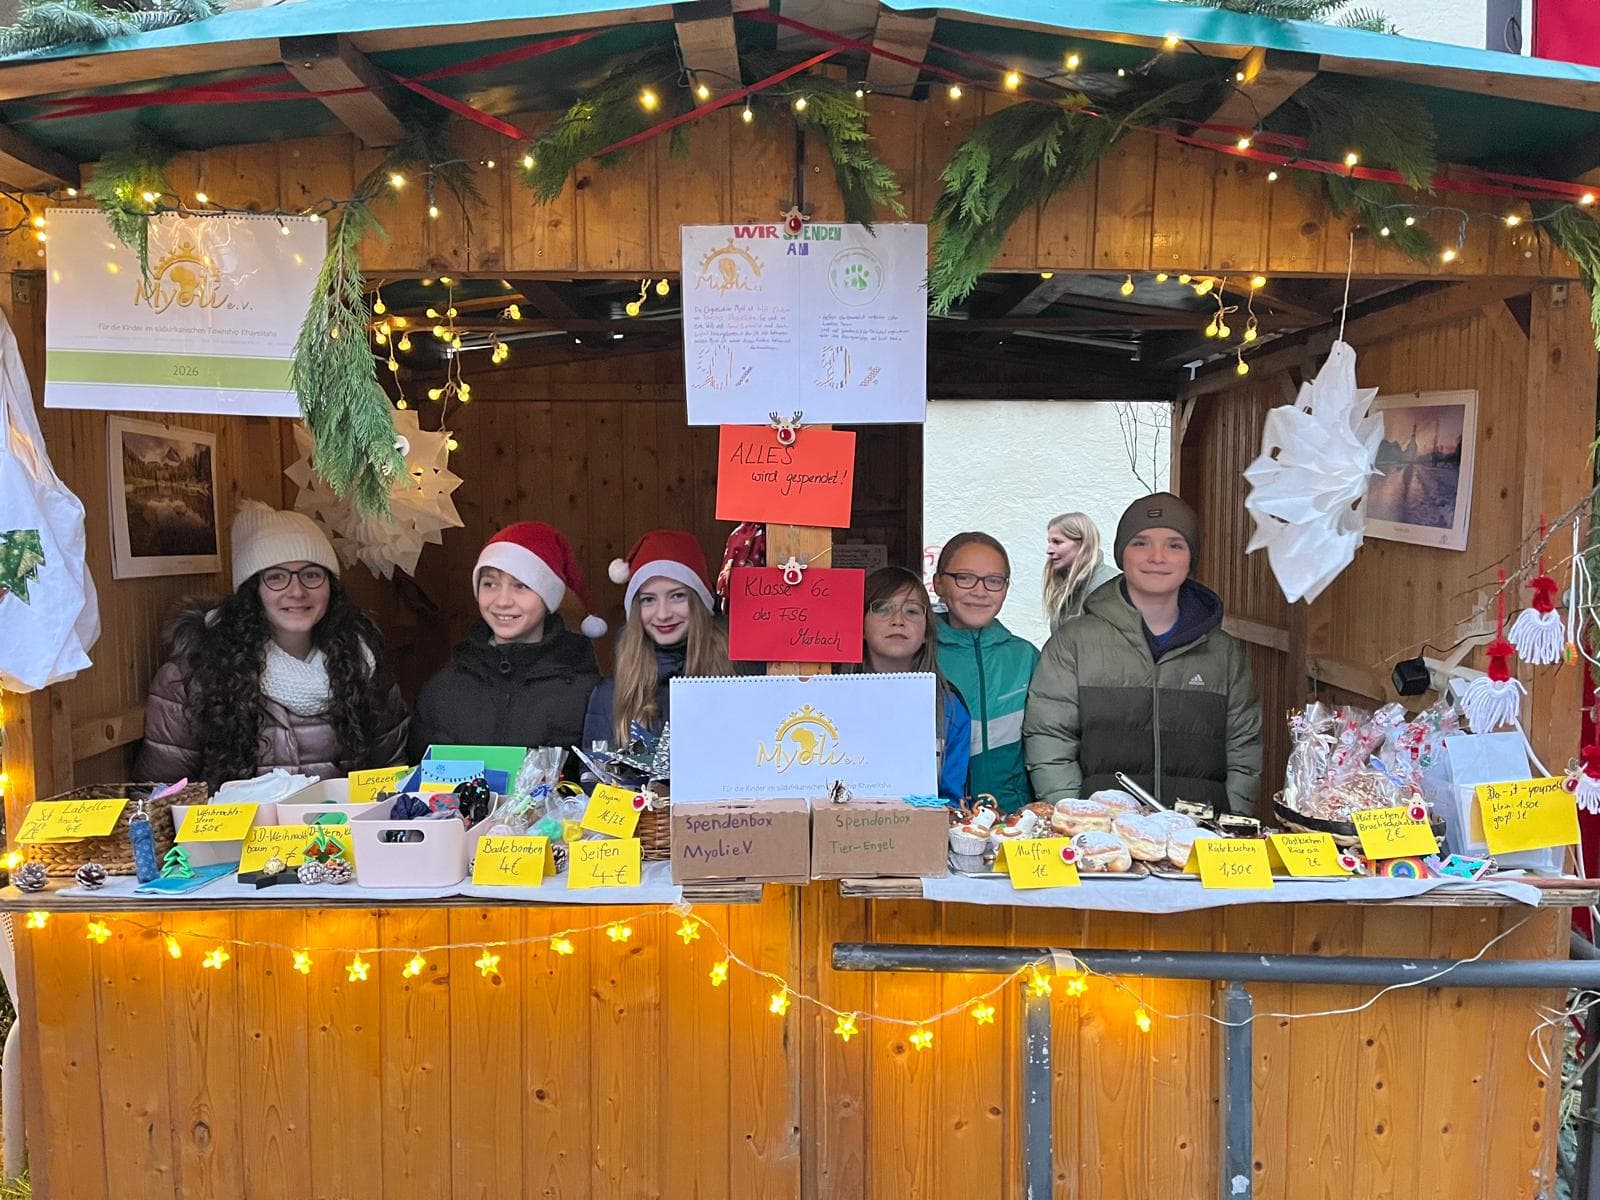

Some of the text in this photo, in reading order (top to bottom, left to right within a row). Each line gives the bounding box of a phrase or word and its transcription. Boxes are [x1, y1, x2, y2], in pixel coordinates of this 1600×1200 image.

[733, 225, 842, 241] WIR SENDEN
[786, 242, 809, 256] AN
[97, 322, 109, 331] Für
[110, 323, 122, 331] die
[122, 323, 143, 332] Kinder
[207, 326, 240, 337] Township
[173, 364, 199, 377] 2026
[729, 441, 795, 465] ALLES
[751, 470, 778, 483] wird
[744, 575, 830, 597] Klasse 6c
[752, 607, 771, 621] des
[789, 628, 843, 652] Marbach
[757, 731, 846, 774] Myoli
[721, 784, 733, 793] Für
[745, 783, 765, 792] Kinder
[686, 813, 773, 834] Spendenbox
[835, 810, 912, 831] Spendenbox
[246, 845, 268, 854] baum
[482, 838, 544, 855] Badebomben
[580, 843, 620, 862] Seifen
[828, 837, 896, 854] Tier-Engel
[1015, 842, 1051, 861] Muffins
[499, 855, 522, 876] 4€
[1305, 857, 1321, 867] 2€
[1032, 864, 1048, 878] 1€
